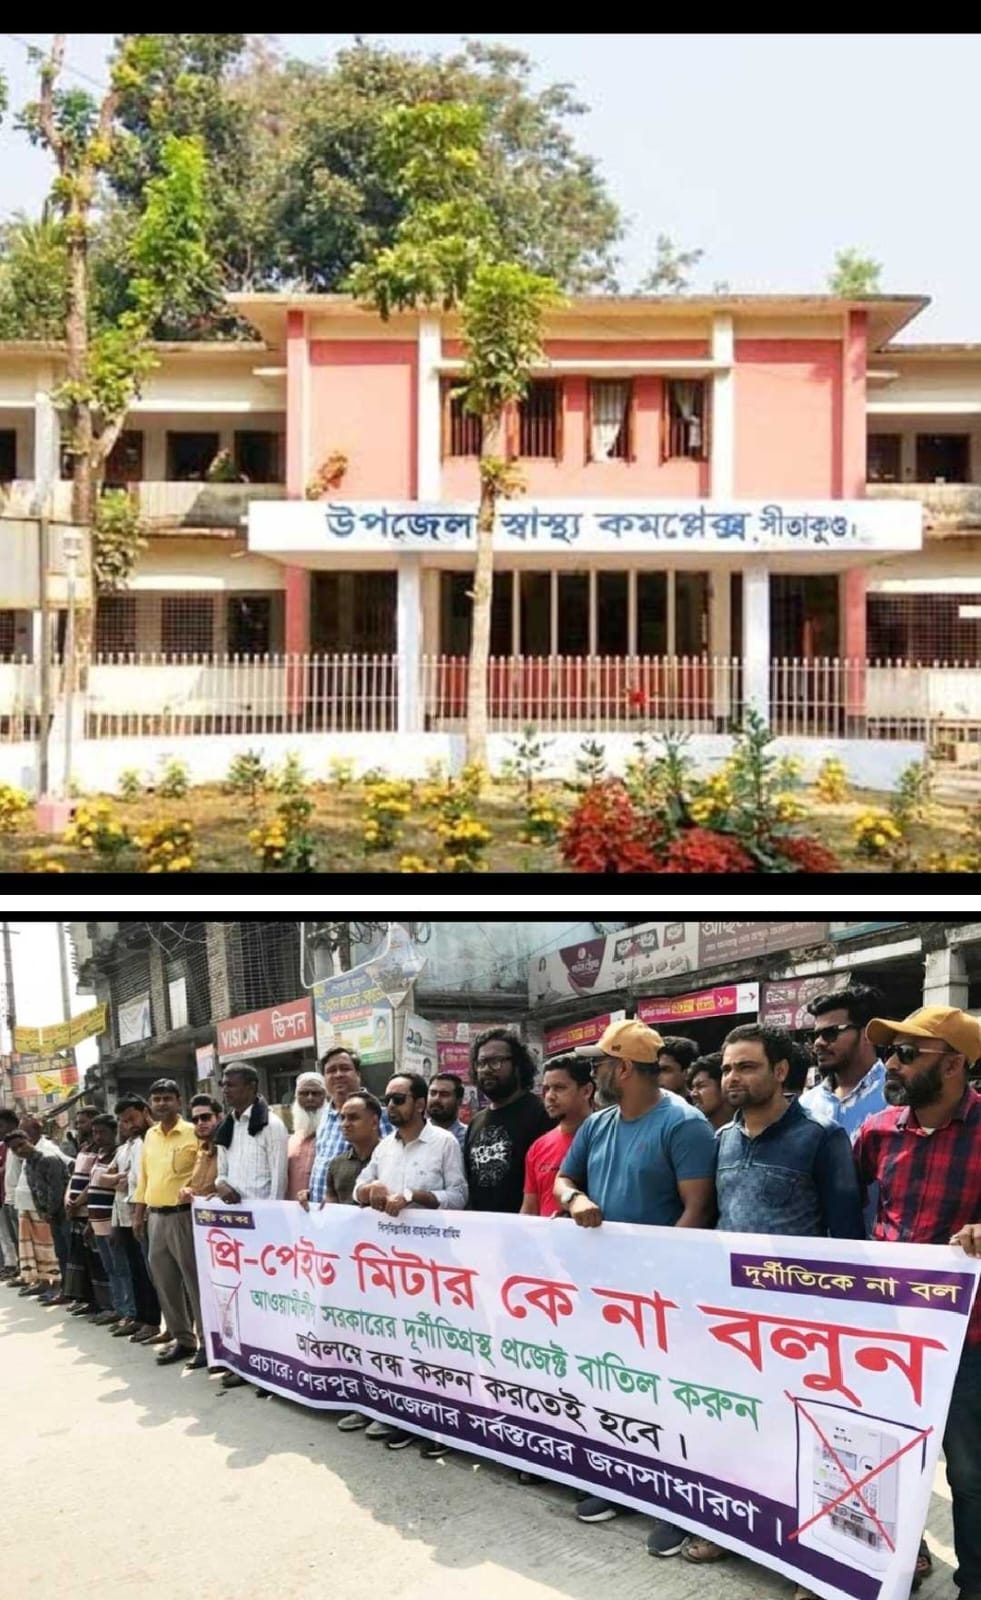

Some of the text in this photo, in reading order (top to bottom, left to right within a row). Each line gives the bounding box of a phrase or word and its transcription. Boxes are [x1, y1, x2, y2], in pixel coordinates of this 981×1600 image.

[325, 503, 480, 541] উপজেল
[499, 507, 583, 543] স্বাস্থ্য
[221, 1023, 260, 1050] VISION
[272, 1010, 307, 1040] ভিশন
[206, 1228, 949, 1407] প্রি-পেইড মিটার কে না বলুন
[863, 1276, 899, 1297] না
[907, 1281, 962, 1303] বল
[320, 1305, 397, 1339] সরকারের
[501, 1337, 569, 1378] প্রজেক্ট
[575, 1352, 661, 1404] বাতিল
[668, 1379, 763, 1431] করুন
[366, 1350, 404, 1377] বন্ধ
[409, 1358, 474, 1396] করুন
[480, 1375, 586, 1432] করতেই
[593, 1407, 665, 1451] হবে
[297, 1370, 360, 1399] শেরপুর
[363, 1376, 460, 1429] উপজেলার
[466, 1413, 575, 1465] সর্বস্তরের
[583, 1447, 761, 1533] জনসাধারণ
